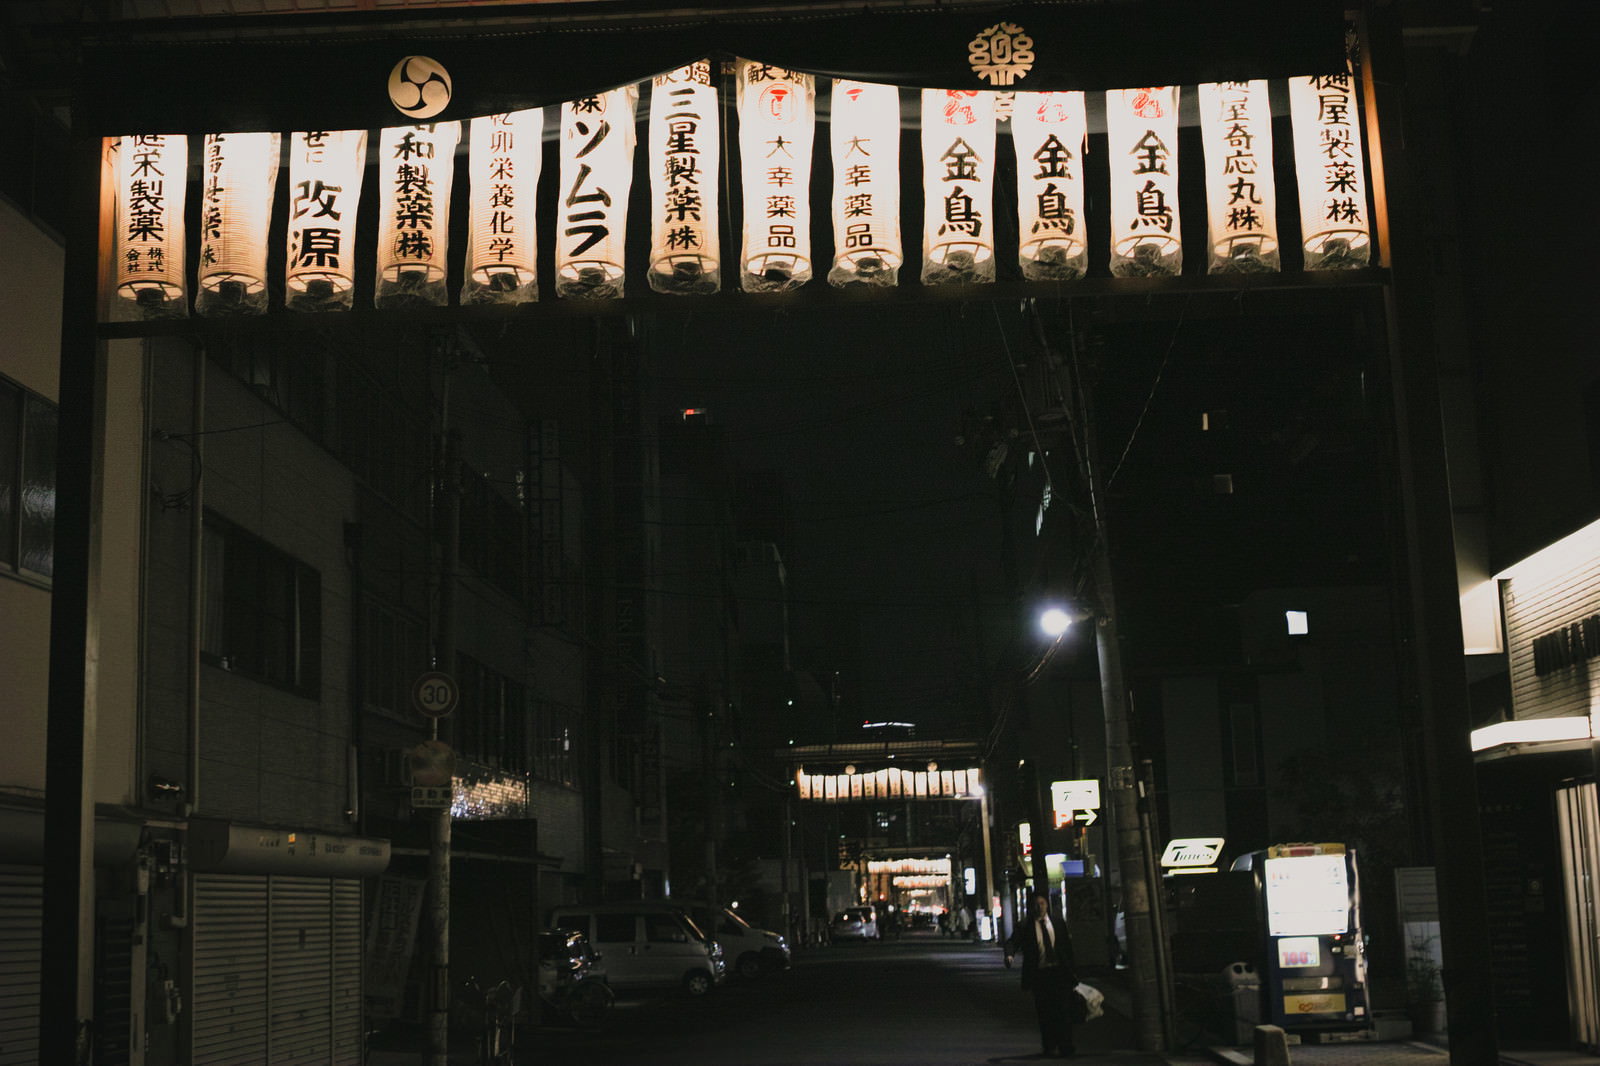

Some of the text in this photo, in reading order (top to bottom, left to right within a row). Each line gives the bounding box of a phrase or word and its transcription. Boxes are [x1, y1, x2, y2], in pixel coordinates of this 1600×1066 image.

[291, 180, 343, 270] 改源
[766, 135, 796, 248] 大幸薬品
[844, 135, 873, 248] 大幸薬品
[938, 136, 983, 238] 金鳥
[1032, 133, 1075, 236] 金鳥
[1129, 129, 1173, 234] 金鳥
[423, 684, 449, 705] 30
[1282, 951, 1309, 966] 100
